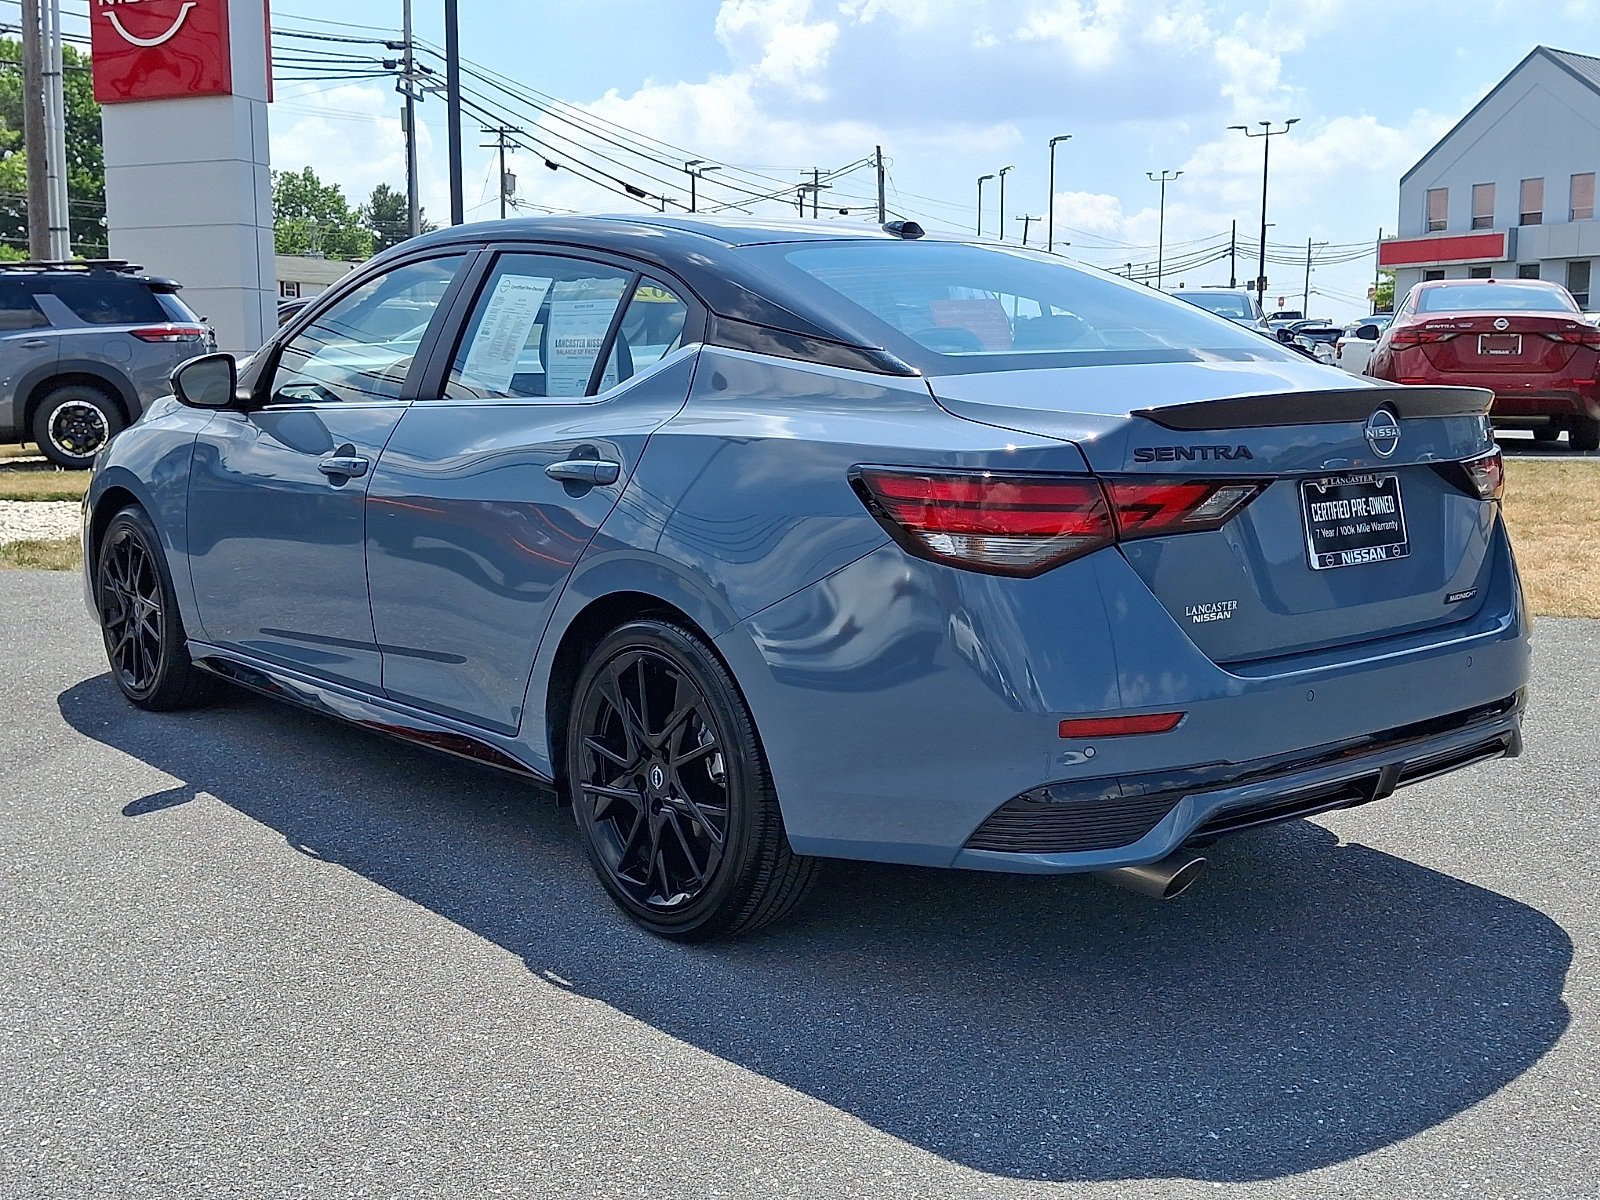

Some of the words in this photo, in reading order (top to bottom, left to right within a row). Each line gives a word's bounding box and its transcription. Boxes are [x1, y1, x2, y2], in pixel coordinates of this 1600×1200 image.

[555, 338, 586, 348] LANCASTER
[1365, 427, 1402, 438] NISSAN
[1133, 444, 1254, 463] SENTRA
[1330, 475, 1374, 486] LANCASTER
[1311, 501, 1350, 522] CERTIFIED
[1351, 495, 1395, 517] PRE-OWNED
[1316, 529, 1320, 538] 7
[1320, 527, 1335, 538] Year
[1339, 524, 1356, 536] 100k
[1356, 522, 1371, 534] Mile
[1371, 520, 1398, 533] Warranty
[1341, 547, 1387, 565] NISSAN
[1450, 590, 1477, 602] MIDNIGHT
[1185, 600, 1238, 617] LANCASTER
[1192, 611, 1231, 624] NISSAN
